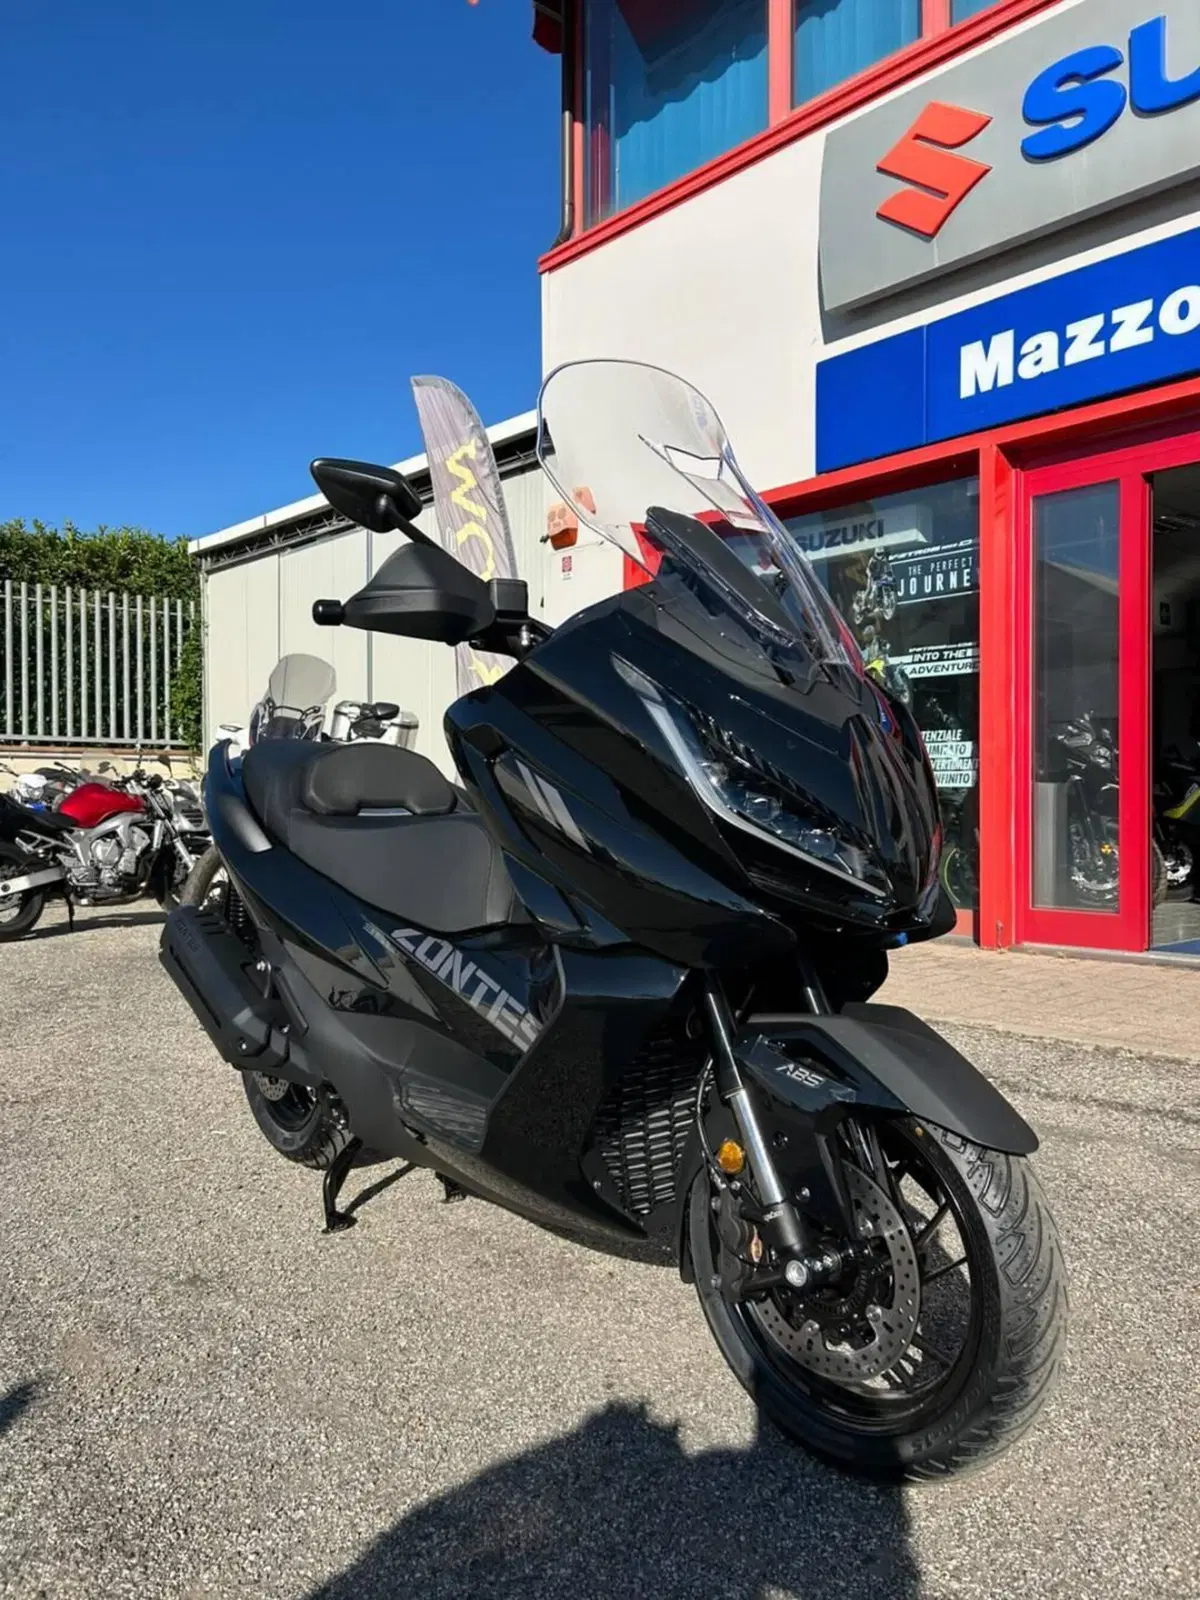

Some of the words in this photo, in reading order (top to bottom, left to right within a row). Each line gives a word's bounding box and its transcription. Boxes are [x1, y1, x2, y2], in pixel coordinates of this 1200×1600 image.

[960, 284, 1200, 399] Mazzo
[796, 519, 884, 553] SUZUKI
[908, 565, 921, 576] THE
[930, 556, 972, 573] PERFECT
[897, 568, 972, 597] JOURNE
[913, 651, 940, 662] INTO
[942, 649, 967, 659] THE
[920, 729, 963, 742] TENZIALE
[391, 928, 544, 1053] ZONTES
[775, 1063, 825, 1088] ABS
